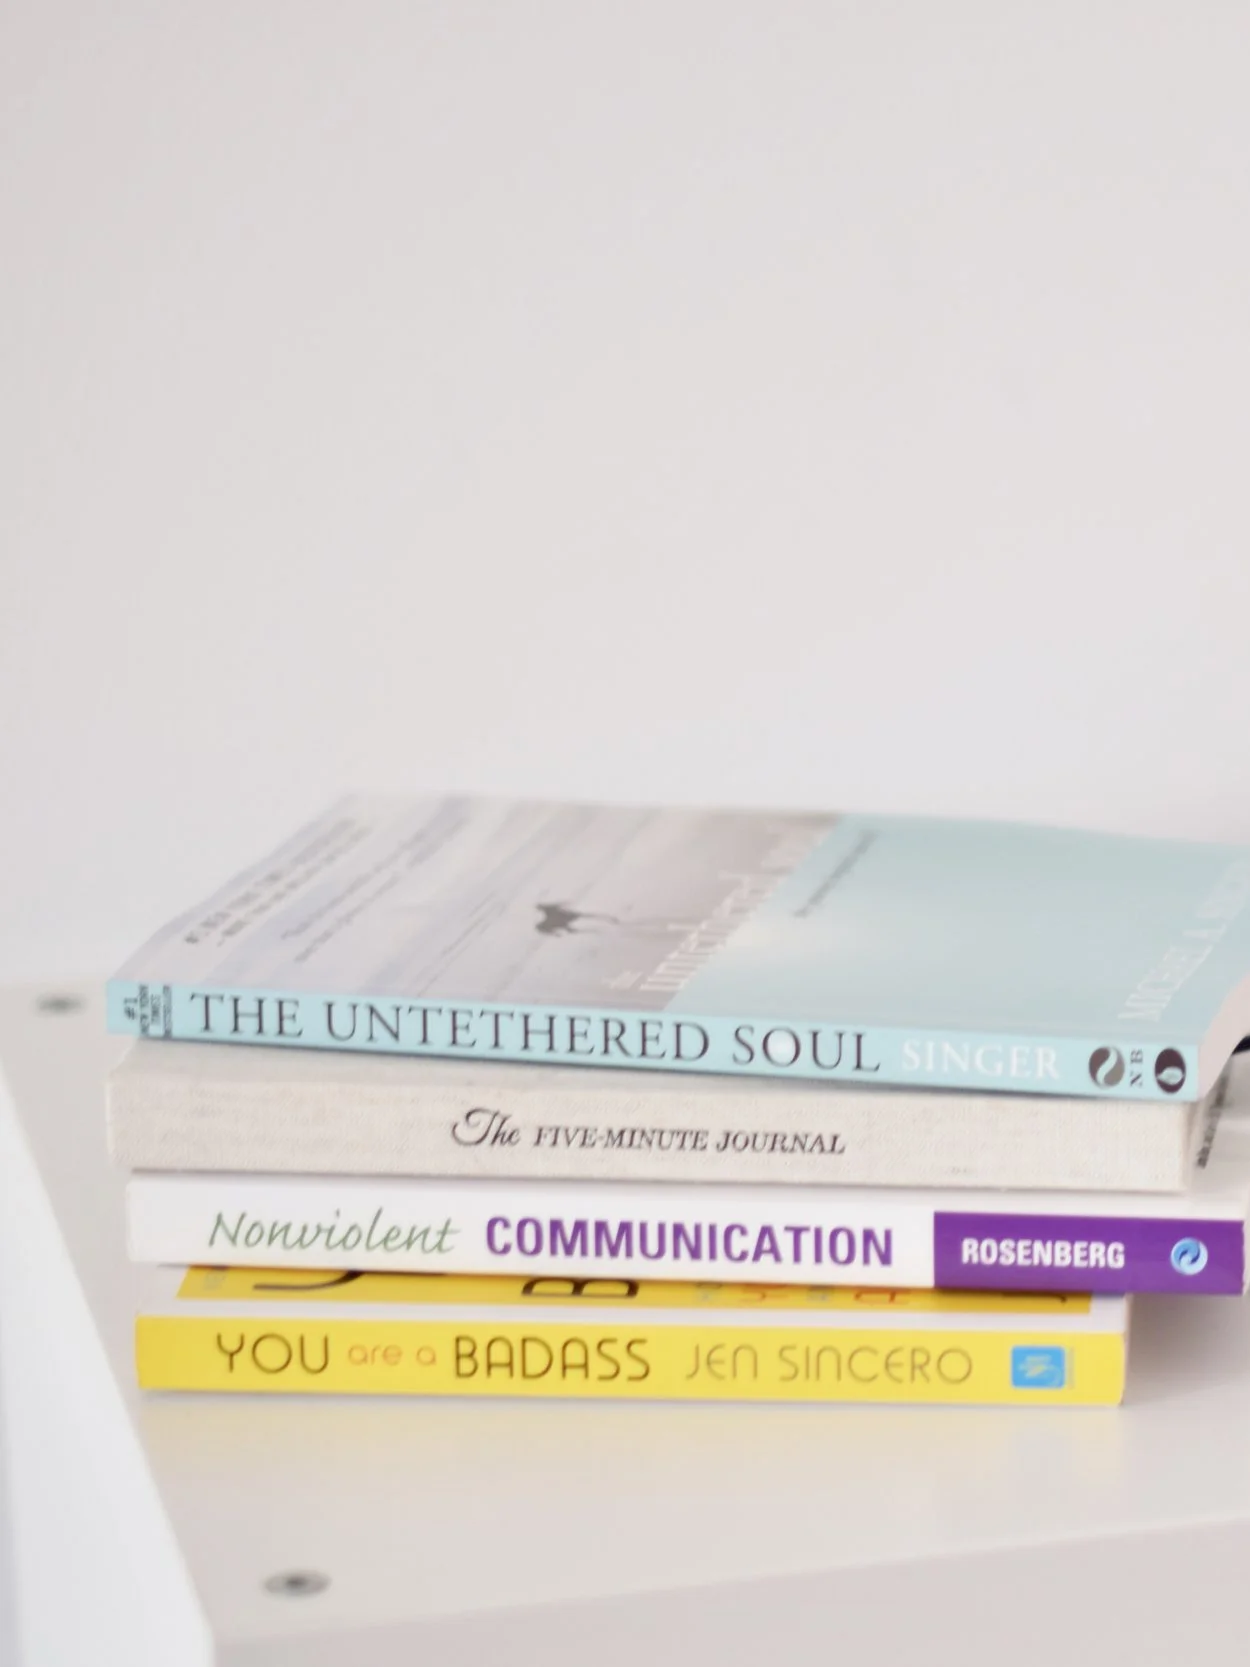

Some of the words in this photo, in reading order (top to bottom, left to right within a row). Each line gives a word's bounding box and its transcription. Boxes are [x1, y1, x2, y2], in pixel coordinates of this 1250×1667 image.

[190, 993, 304, 1038] THE
[323, 1001, 710, 1062] UNTETHERED
[731, 1024, 881, 1073] SOUL
[901, 1038, 1061, 1080] SINGER
[451, 1107, 521, 1148] The
[532, 1125, 710, 1154] FIVE-MINUTE
[715, 1130, 846, 1155] JOURNAL
[207, 1206, 462, 1253] Nonviolent
[485, 1216, 893, 1267] COMMUNICATION
[961, 1237, 1126, 1269] ROSENBERG
[216, 1332, 330, 1375] YOU
[347, 1343, 402, 1367] are
[415, 1344, 438, 1367] a
[454, 1334, 651, 1383] BADASS
[685, 1342, 758, 1381] JEN
[778, 1344, 974, 1385] SINCERO
